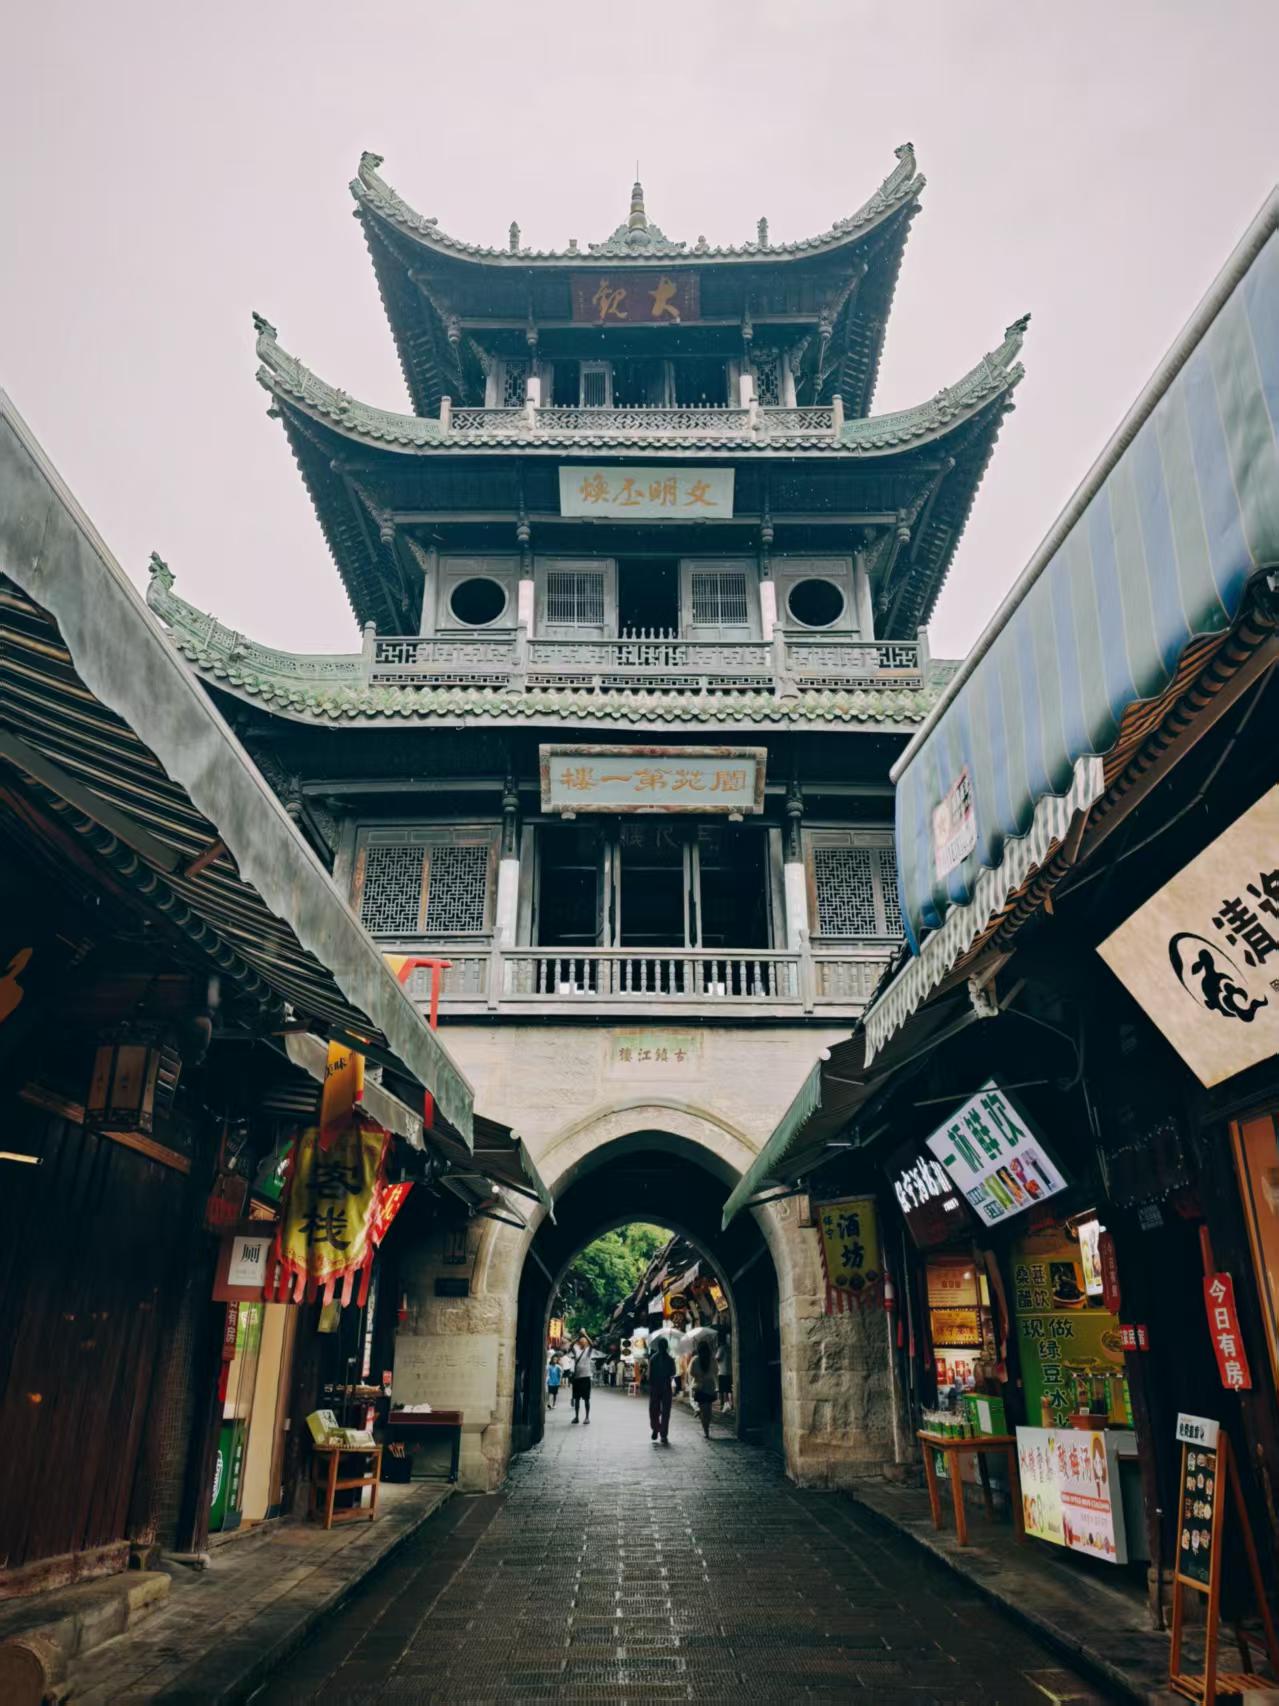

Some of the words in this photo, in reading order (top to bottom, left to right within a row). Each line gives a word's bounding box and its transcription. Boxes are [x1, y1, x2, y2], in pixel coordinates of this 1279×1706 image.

[838, 1213, 865, 1269] 酒坊
[1016, 1289, 1050, 1310] 醋饮
[1022, 1318, 1074, 1338] 现做
[1210, 1280, 1243, 1385] 今日有房
